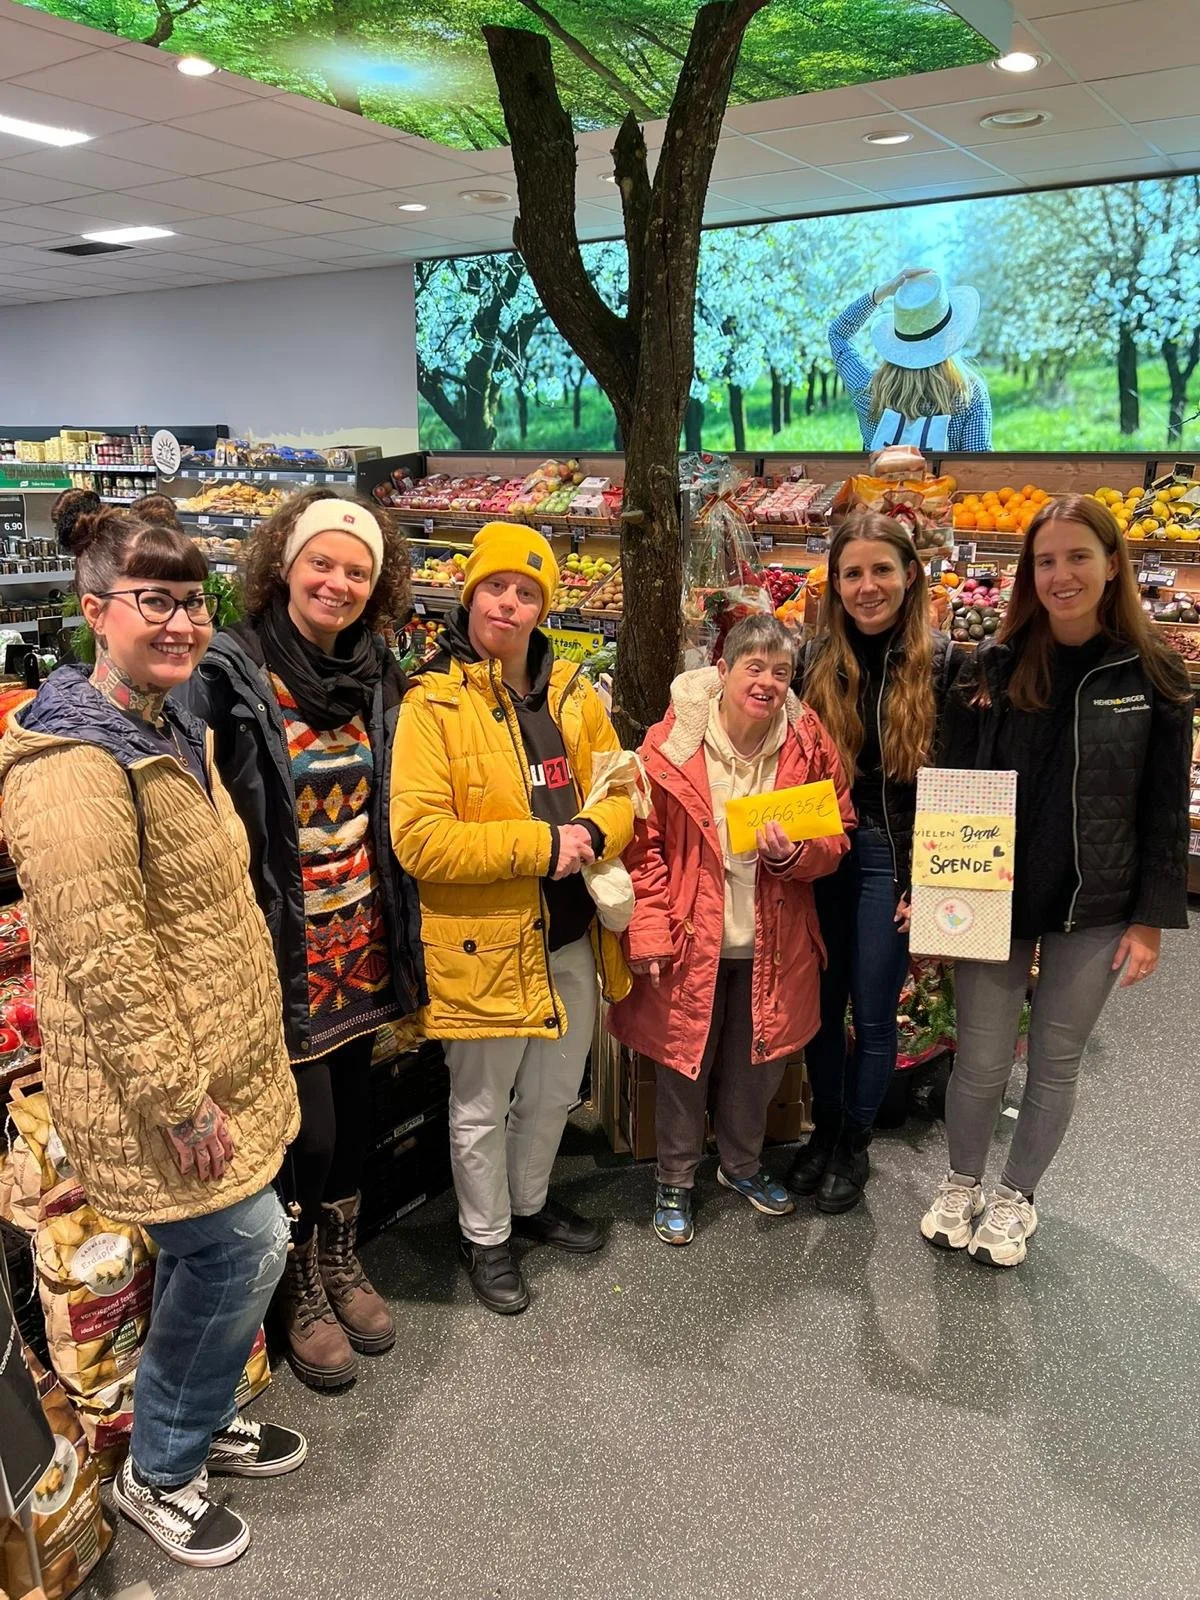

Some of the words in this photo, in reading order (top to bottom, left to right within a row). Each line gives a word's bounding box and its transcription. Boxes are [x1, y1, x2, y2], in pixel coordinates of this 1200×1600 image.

[4, 522, 23, 531] 6.90
[530, 756, 572, 789] U21
[914, 829, 956, 838] VIELEN
[960, 825, 1001, 843] Dank
[930, 855, 993, 875] SPENDE
